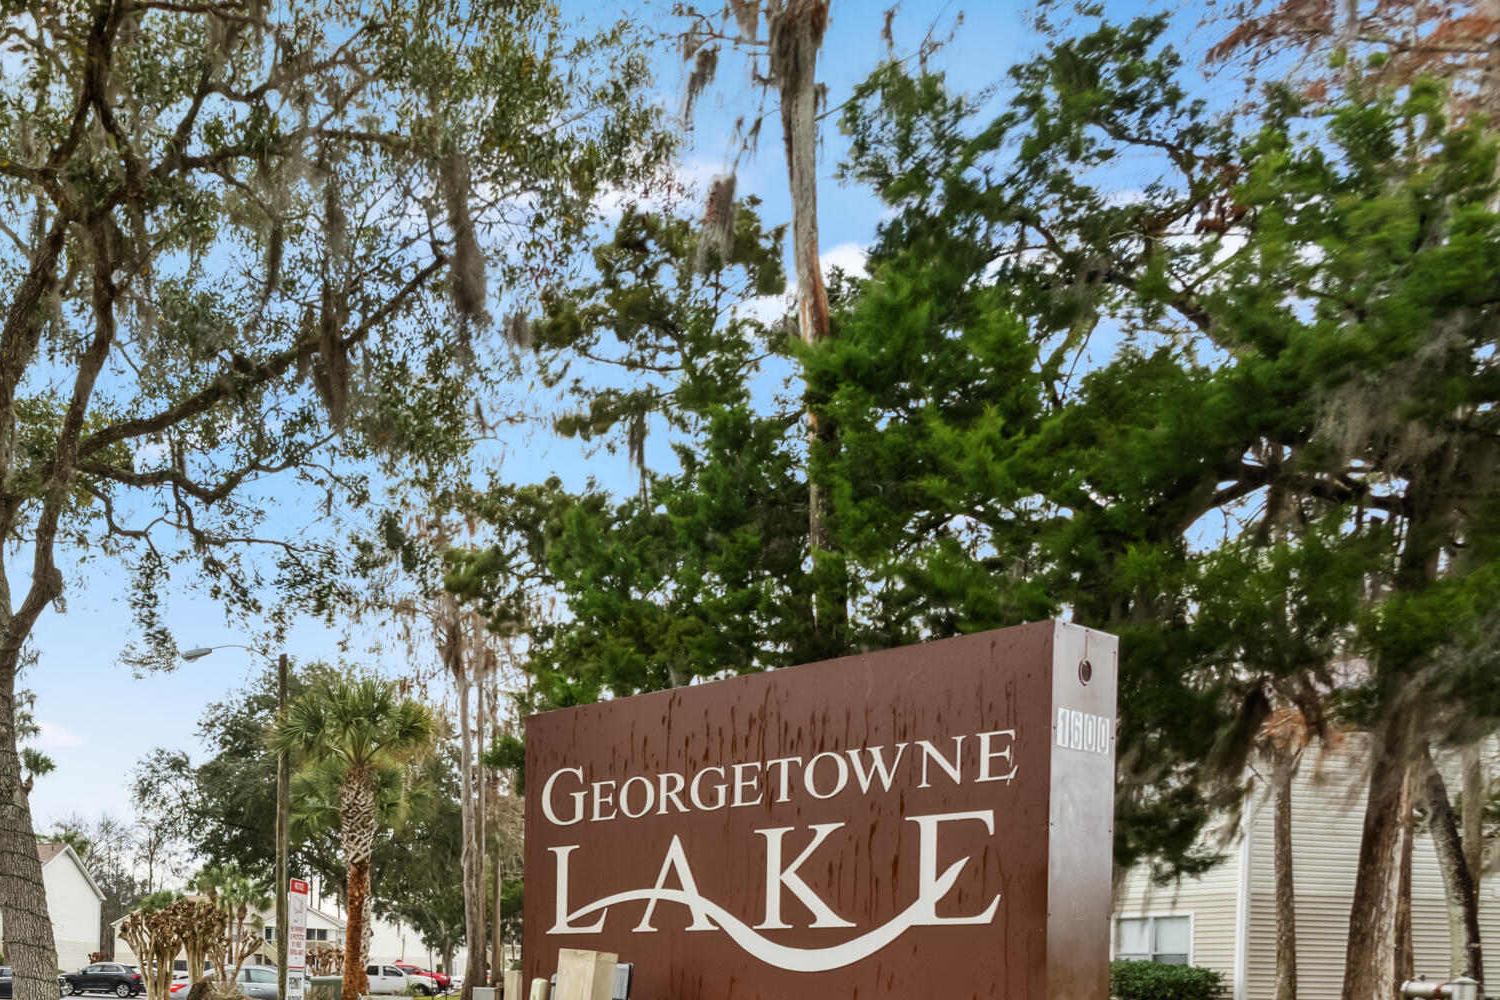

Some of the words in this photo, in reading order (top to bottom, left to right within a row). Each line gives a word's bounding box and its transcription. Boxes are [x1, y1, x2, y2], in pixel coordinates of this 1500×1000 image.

[1059, 709, 1109, 754] 1600
[541, 729, 1018, 826] GEORGETOWNE
[546, 808, 1002, 972] LAKE
[288, 977, 302, 989] PERMIT
